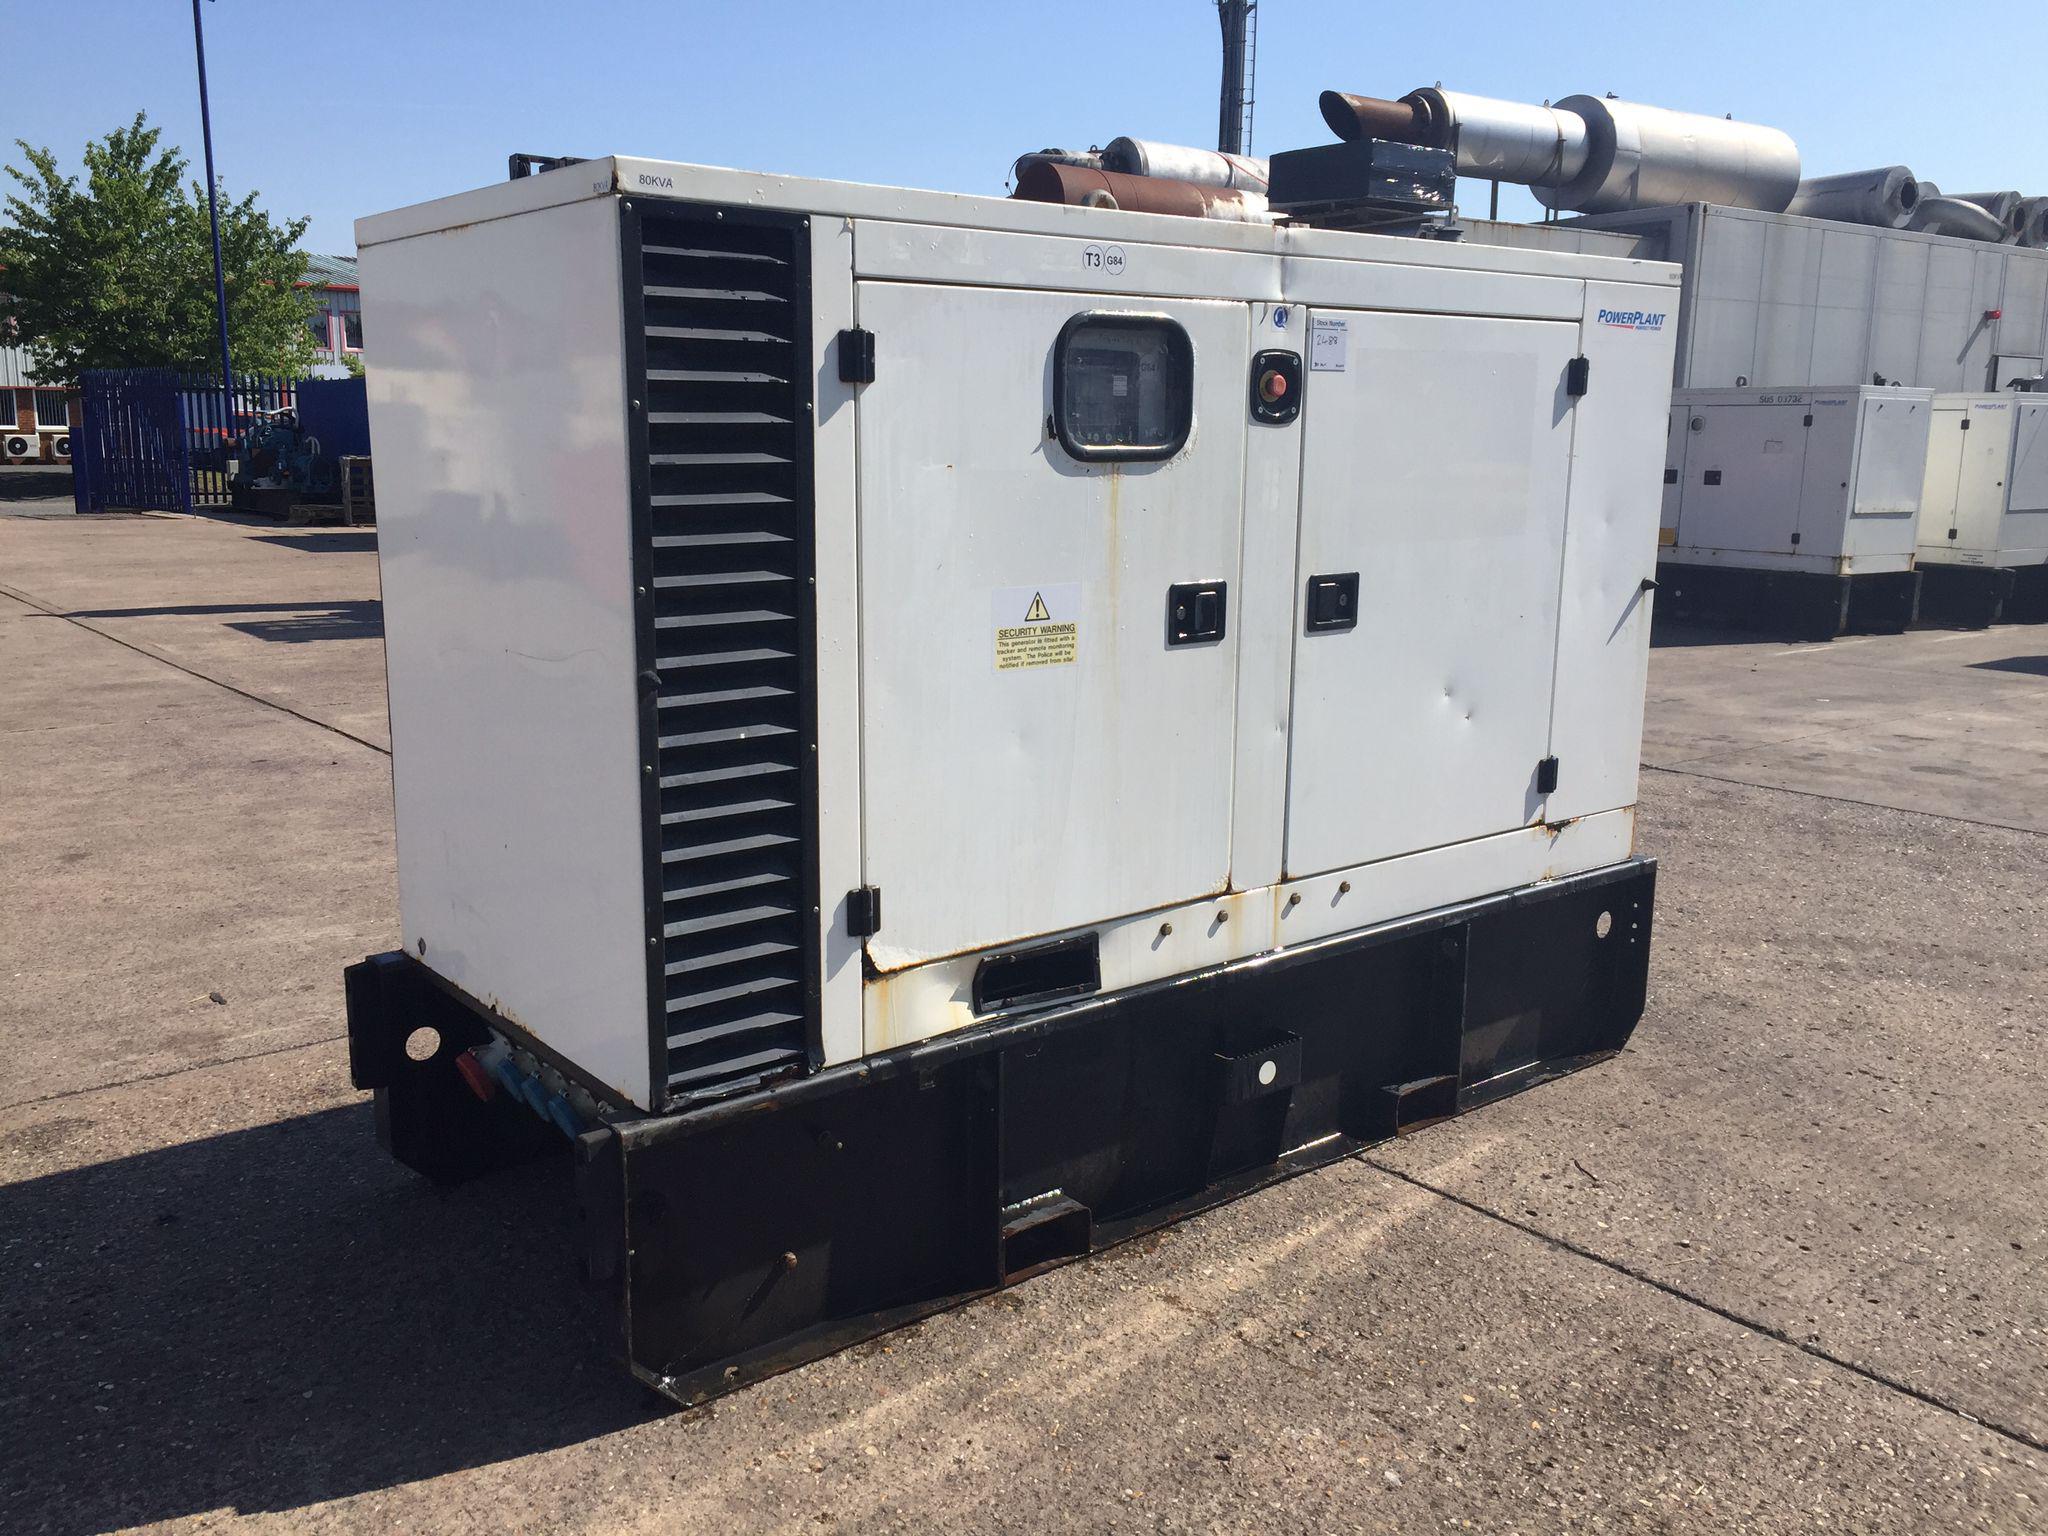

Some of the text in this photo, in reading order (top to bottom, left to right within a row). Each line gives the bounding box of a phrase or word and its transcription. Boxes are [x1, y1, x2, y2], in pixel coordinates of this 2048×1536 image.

[639, 174, 673, 189] 80KVA
[1085, 252, 1101, 267] T3
[1106, 255, 1123, 266] G84
[1316, 334, 1339, 346] 2488
[998, 623, 1075, 638] SECURITY WARNING
[1011, 639, 1036, 647] generator
[999, 661, 1019, 669] notified
[1025, 659, 1048, 667] removed
